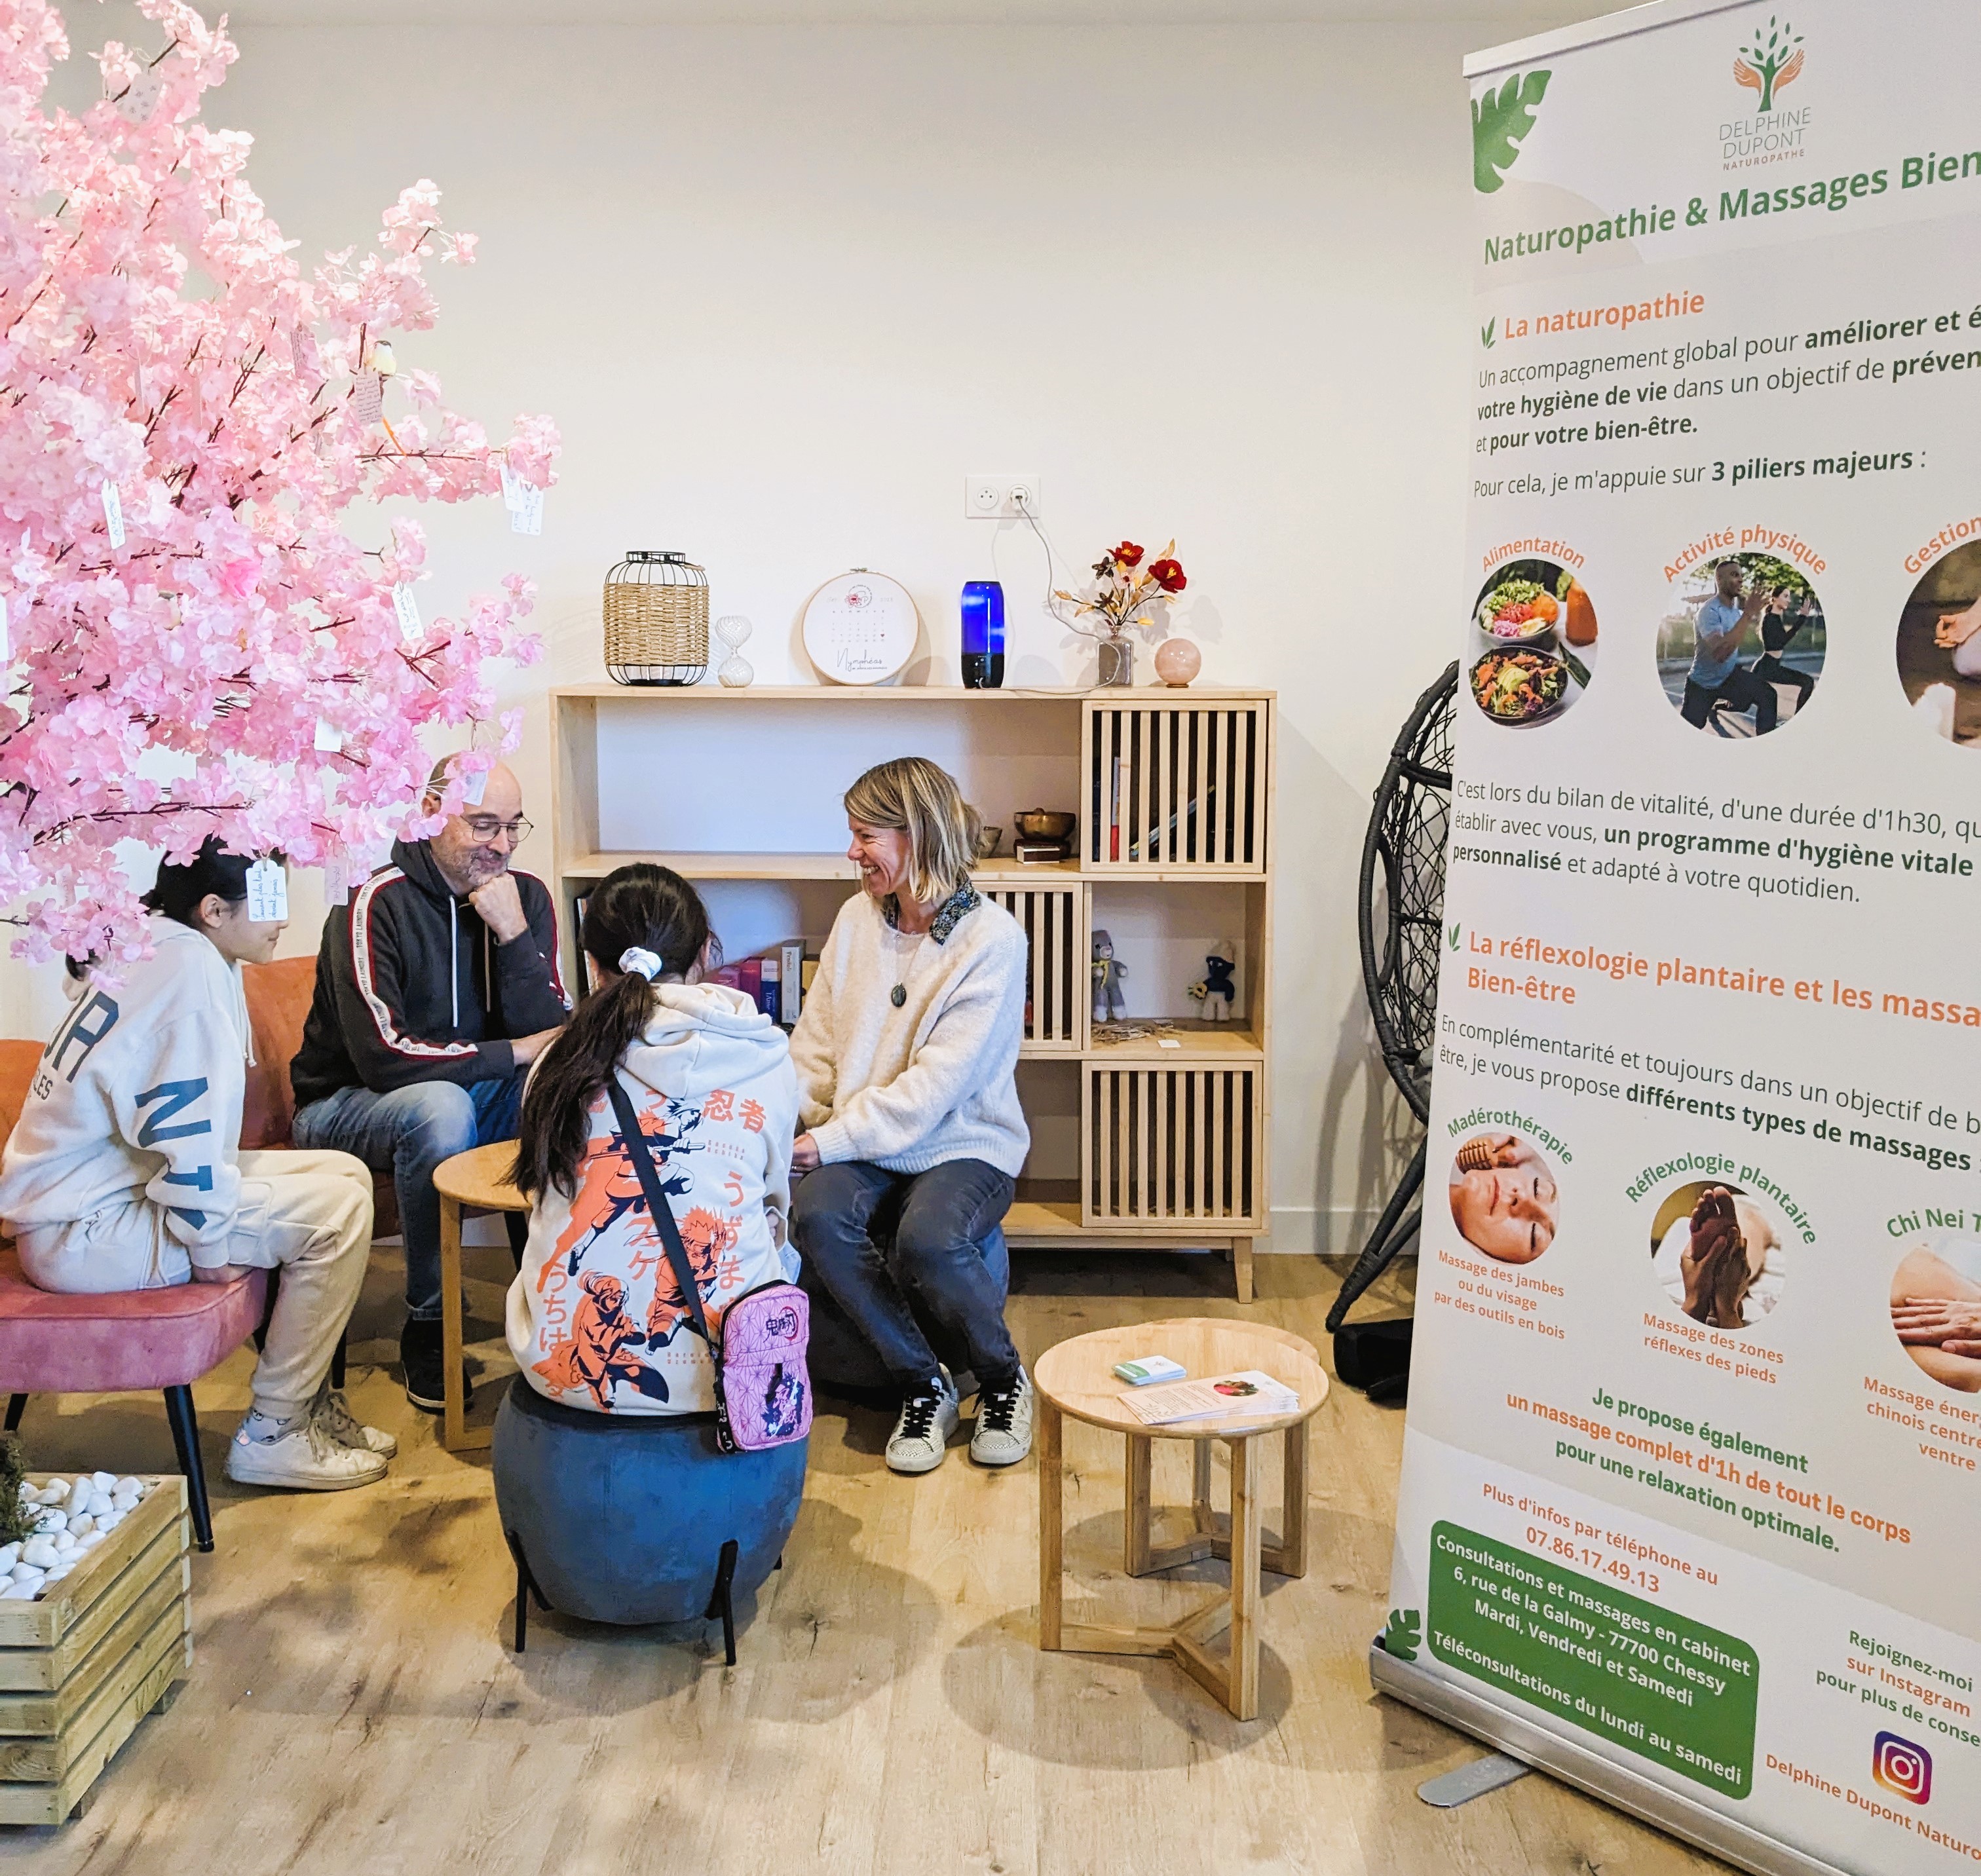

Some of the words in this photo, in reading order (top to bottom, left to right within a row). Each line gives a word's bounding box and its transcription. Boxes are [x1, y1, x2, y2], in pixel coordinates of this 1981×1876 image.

[1720, 107, 1811, 140] DELPHINE
[1724, 128, 1805, 159] DUPONT
[1723, 149, 1804, 171] NATUROPATHE
[1485, 204, 1676, 265] Naturopathie
[1686, 197, 1708, 226] &
[1720, 170, 1888, 221] Massages
[1902, 151, 1981, 189] Bien
[1504, 317, 1528, 340] La
[1536, 290, 1704, 334] naturopathie
[1480, 370, 1496, 388] Un
[1500, 348, 1669, 386] accompagnement
[1673, 336, 1737, 369] global
[1745, 335, 1799, 362] pour
[1805, 318, 1927, 349] améliorer
[1934, 310, 1961, 333] et
[1476, 436, 1487, 453] et
[1490, 432, 1530, 456] pour
[1535, 426, 1588, 445] votre
[1595, 415, 1697, 441] bien-être.
[1482, 537, 1585, 572] Alimentation
[1663, 525, 1735, 583] Activité
[1740, 523, 1826, 574] physique
[1904, 517, 1981, 574] Gestion
[1457, 779, 1486, 800] C'est
[1490, 782, 1521, 802] lors
[1527, 785, 1551, 804] du
[1558, 786, 1604, 808] bilan
[1611, 791, 1634, 811] de
[1640, 794, 1714, 819] vitalité,
[1722, 798, 1783, 821] d'une
[1790, 803, 1855, 827] durée
[1863, 808, 1946, 838] d'1h30,
[1452, 846, 1562, 871] personnalisé
[1568, 857, 1587, 874] et
[1592, 857, 1660, 884] adapté
[1667, 863, 1678, 883] à
[1685, 869, 1740, 889] votre
[1748, 876, 1859, 903] quotidien.
[1468, 967, 1575, 1004] Bien-être
[1469, 931, 1492, 955] La
[1500, 937, 1648, 980] réflexologie
[1657, 958, 1784, 996] plantaire
[1794, 980, 1823, 1002] et
[1833, 979, 1872, 1009] les
[1883, 994, 1981, 1027] massa
[1442, 1015, 1456, 1034] En
[1460, 1024, 1614, 1064] complémentarité
[1621, 1052, 1640, 1070] et
[1646, 1055, 1733, 1085] toujours
[1741, 1070, 1792, 1097] dans
[1800, 1085, 1827, 1104] un
[1836, 1088, 1923, 1122] objectif
[1928, 1106, 1957, 1130] de
[702, 1089, 766, 1134] 忍者
[1439, 1043, 1468, 1071] être,
[1471, 1053, 1486, 1076] je
[1492, 1061, 1534, 1082] vous
[1541, 1071, 1619, 1098] propose
[1627, 1083, 1735, 1121] différents
[1742, 1106, 1805, 1135] types
[1813, 1119, 1841, 1142] de
[1849, 1131, 1971, 1171] massages
[1447, 1107, 1573, 1165] Madérothérapie
[1625, 1152, 1735, 1203] Réflexologie
[1739, 1165, 1816, 1245] plantaire
[1887, 1210, 1921, 1237] Chi
[1925, 1209, 1963, 1228] Nei
[1439, 1250, 1487, 1277] Massage
[1491, 1267, 1513, 1283] des
[1515, 1273, 1564, 1297] jambes
[1459, 1280, 1473, 1292] ou
[1477, 1283, 1492, 1298] du
[1496, 1290, 1537, 1311] visage
[1435, 1292, 1452, 1305] par
[1455, 1297, 1475, 1313] des
[1479, 1307, 1514, 1324] outils
[1519, 1318, 1534, 1330] en
[1538, 1321, 1564, 1339] bois
[1644, 1313, 1705, 1342] Massage
[1710, 1332, 1735, 1350] des
[1739, 1343, 1783, 1363] zones
[1644, 1336, 1701, 1362] réflexes
[1706, 1353, 1731, 1370] des
[1735, 1363, 1776, 1383] pieds
[1593, 1387, 1613, 1409] Je
[1617, 1400, 1694, 1436] propose
[1699, 1422, 1809, 1474] également
[1864, 1376, 1934, 1411] Massage
[1939, 1400, 1981, 1429] éner
[1867, 1402, 1925, 1431] chinois
[1919, 1443, 1976, 1471] ventre
[1556, 1440, 1596, 1465] pour
[1600, 1456, 1634, 1479] une
[1638, 1469, 1736, 1516] relaxation
[1741, 1507, 1839, 1552] optimale.
[1484, 1484, 1514, 1507] Plus
[1519, 1497, 1570, 1528] d'infos
[1575, 1521, 1602, 1539] par
[1606, 1531, 1691, 1575] téléphone
[1696, 1567, 1718, 1585] au
[1526, 1527, 1659, 1592] 07.86.17.49.13
[1437, 1535, 1543, 1590] Consultations
[1547, 1582, 1564, 1598] et
[1569, 1590, 1650, 1633] massages
[1655, 1626, 1676, 1645] en
[1682, 1638, 1750, 1678] cabinet
[1454, 1566, 1467, 1585] 6,
[1471, 1575, 1497, 1595] rue
[1501, 1586, 1520, 1605] de
[1524, 1594, 1538, 1613] la
[1543, 1604, 1596, 1640] Galmy
[1609, 1630, 1659, 1664] 77700
[1663, 1655, 1726, 1696] Chessy
[1474, 1599, 1524, 1635] Mardi,
[1528, 1622, 1602, 1667] Vendredi
[1606, 1660, 1624, 1677] et
[1628, 1666, 1693, 1707] Samedi
[1849, 1630, 1972, 1693] Rejoignez-moi
[1434, 1630, 1572, 1706] Téléconsultations
[1575, 1697, 1596, 1717] du
[1601, 1706, 1644, 1740] lundi
[1648, 1733, 1670, 1752] au
[1676, 1744, 1741, 1784] samedi
[1817, 1670, 1857, 1694] pour
[1861, 1688, 1897, 1712] plus
[1902, 1704, 1923, 1723] de
[1929, 1717, 1980, 1747] conse
[1847, 1658, 1875, 1676] sur
[1880, 1668, 1970, 1717] Instagram
[1765, 1753, 1841, 1799] Delphine
[1847, 1789, 1912, 1830] Dupont
